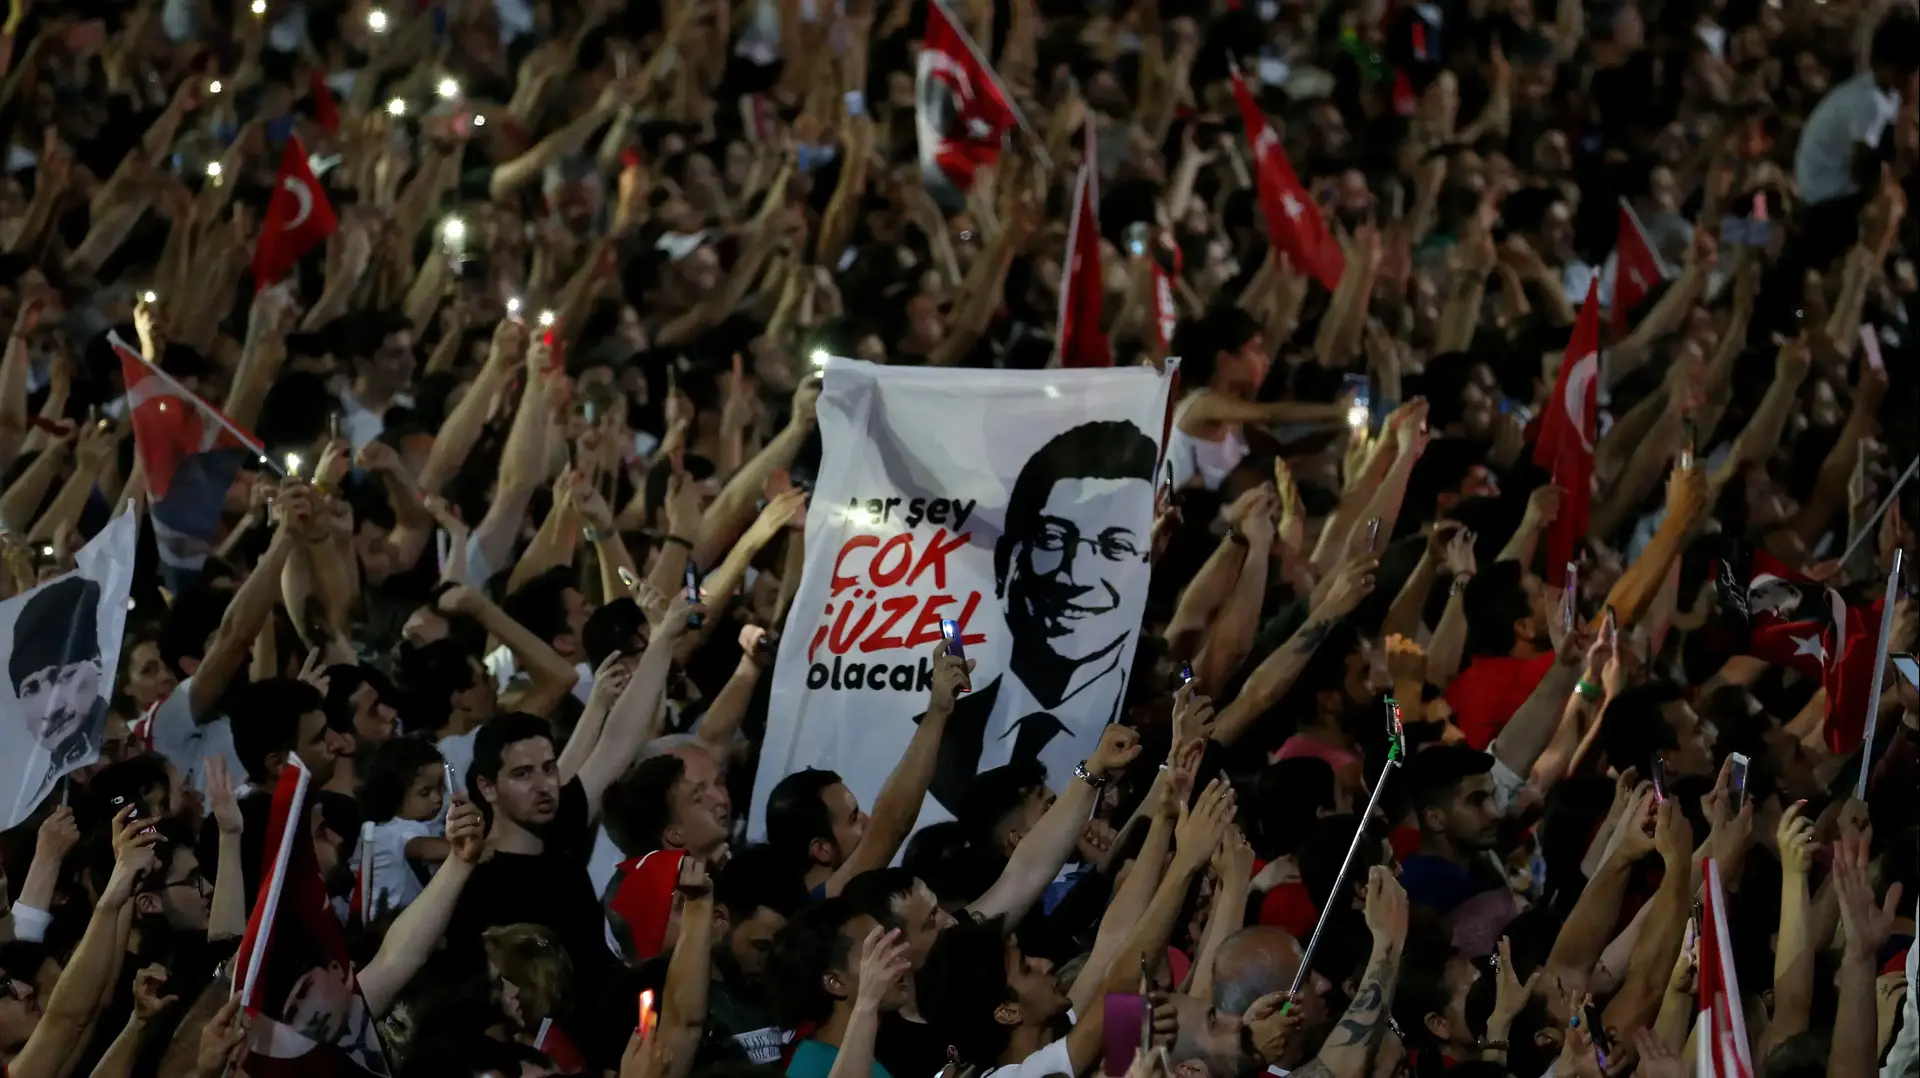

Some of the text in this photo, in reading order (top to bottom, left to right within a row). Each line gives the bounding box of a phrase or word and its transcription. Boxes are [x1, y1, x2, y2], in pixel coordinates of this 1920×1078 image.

[849, 497, 976, 531] er şey
[830, 528, 972, 597] ÇOK
[806, 655, 934, 692] olacak
